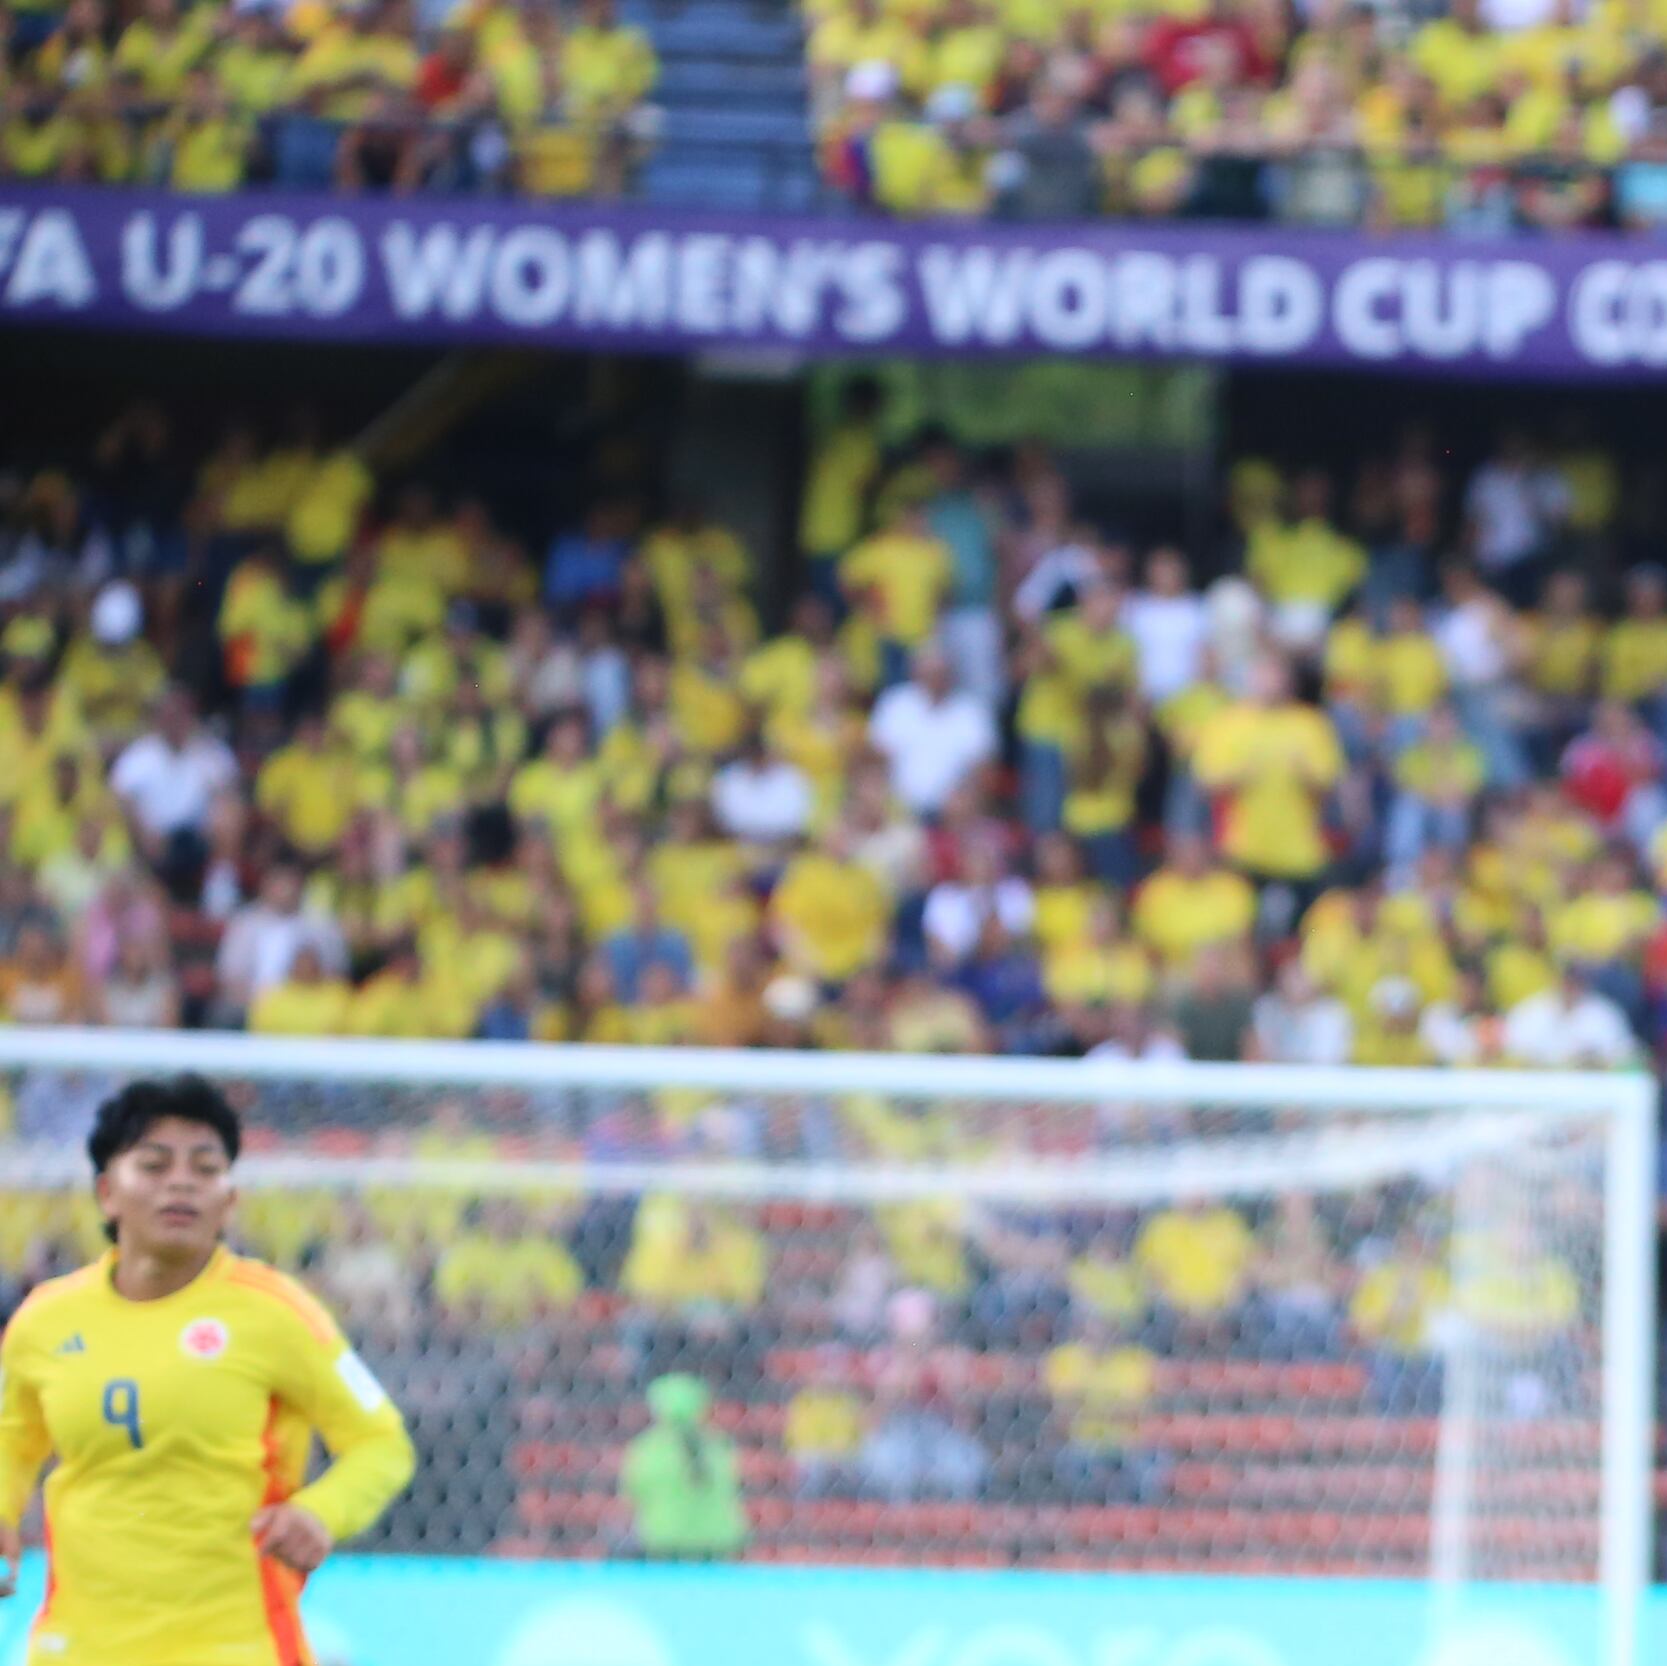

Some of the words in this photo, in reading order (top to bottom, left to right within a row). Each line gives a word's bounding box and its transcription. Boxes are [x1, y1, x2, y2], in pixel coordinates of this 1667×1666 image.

[121, 208, 368, 319] U-20
[379, 219, 907, 343] WOMEN'S
[918, 245, 1324, 354] WORLD
[1333, 256, 1556, 360] CUP
[103, 1377, 144, 1449] 9
